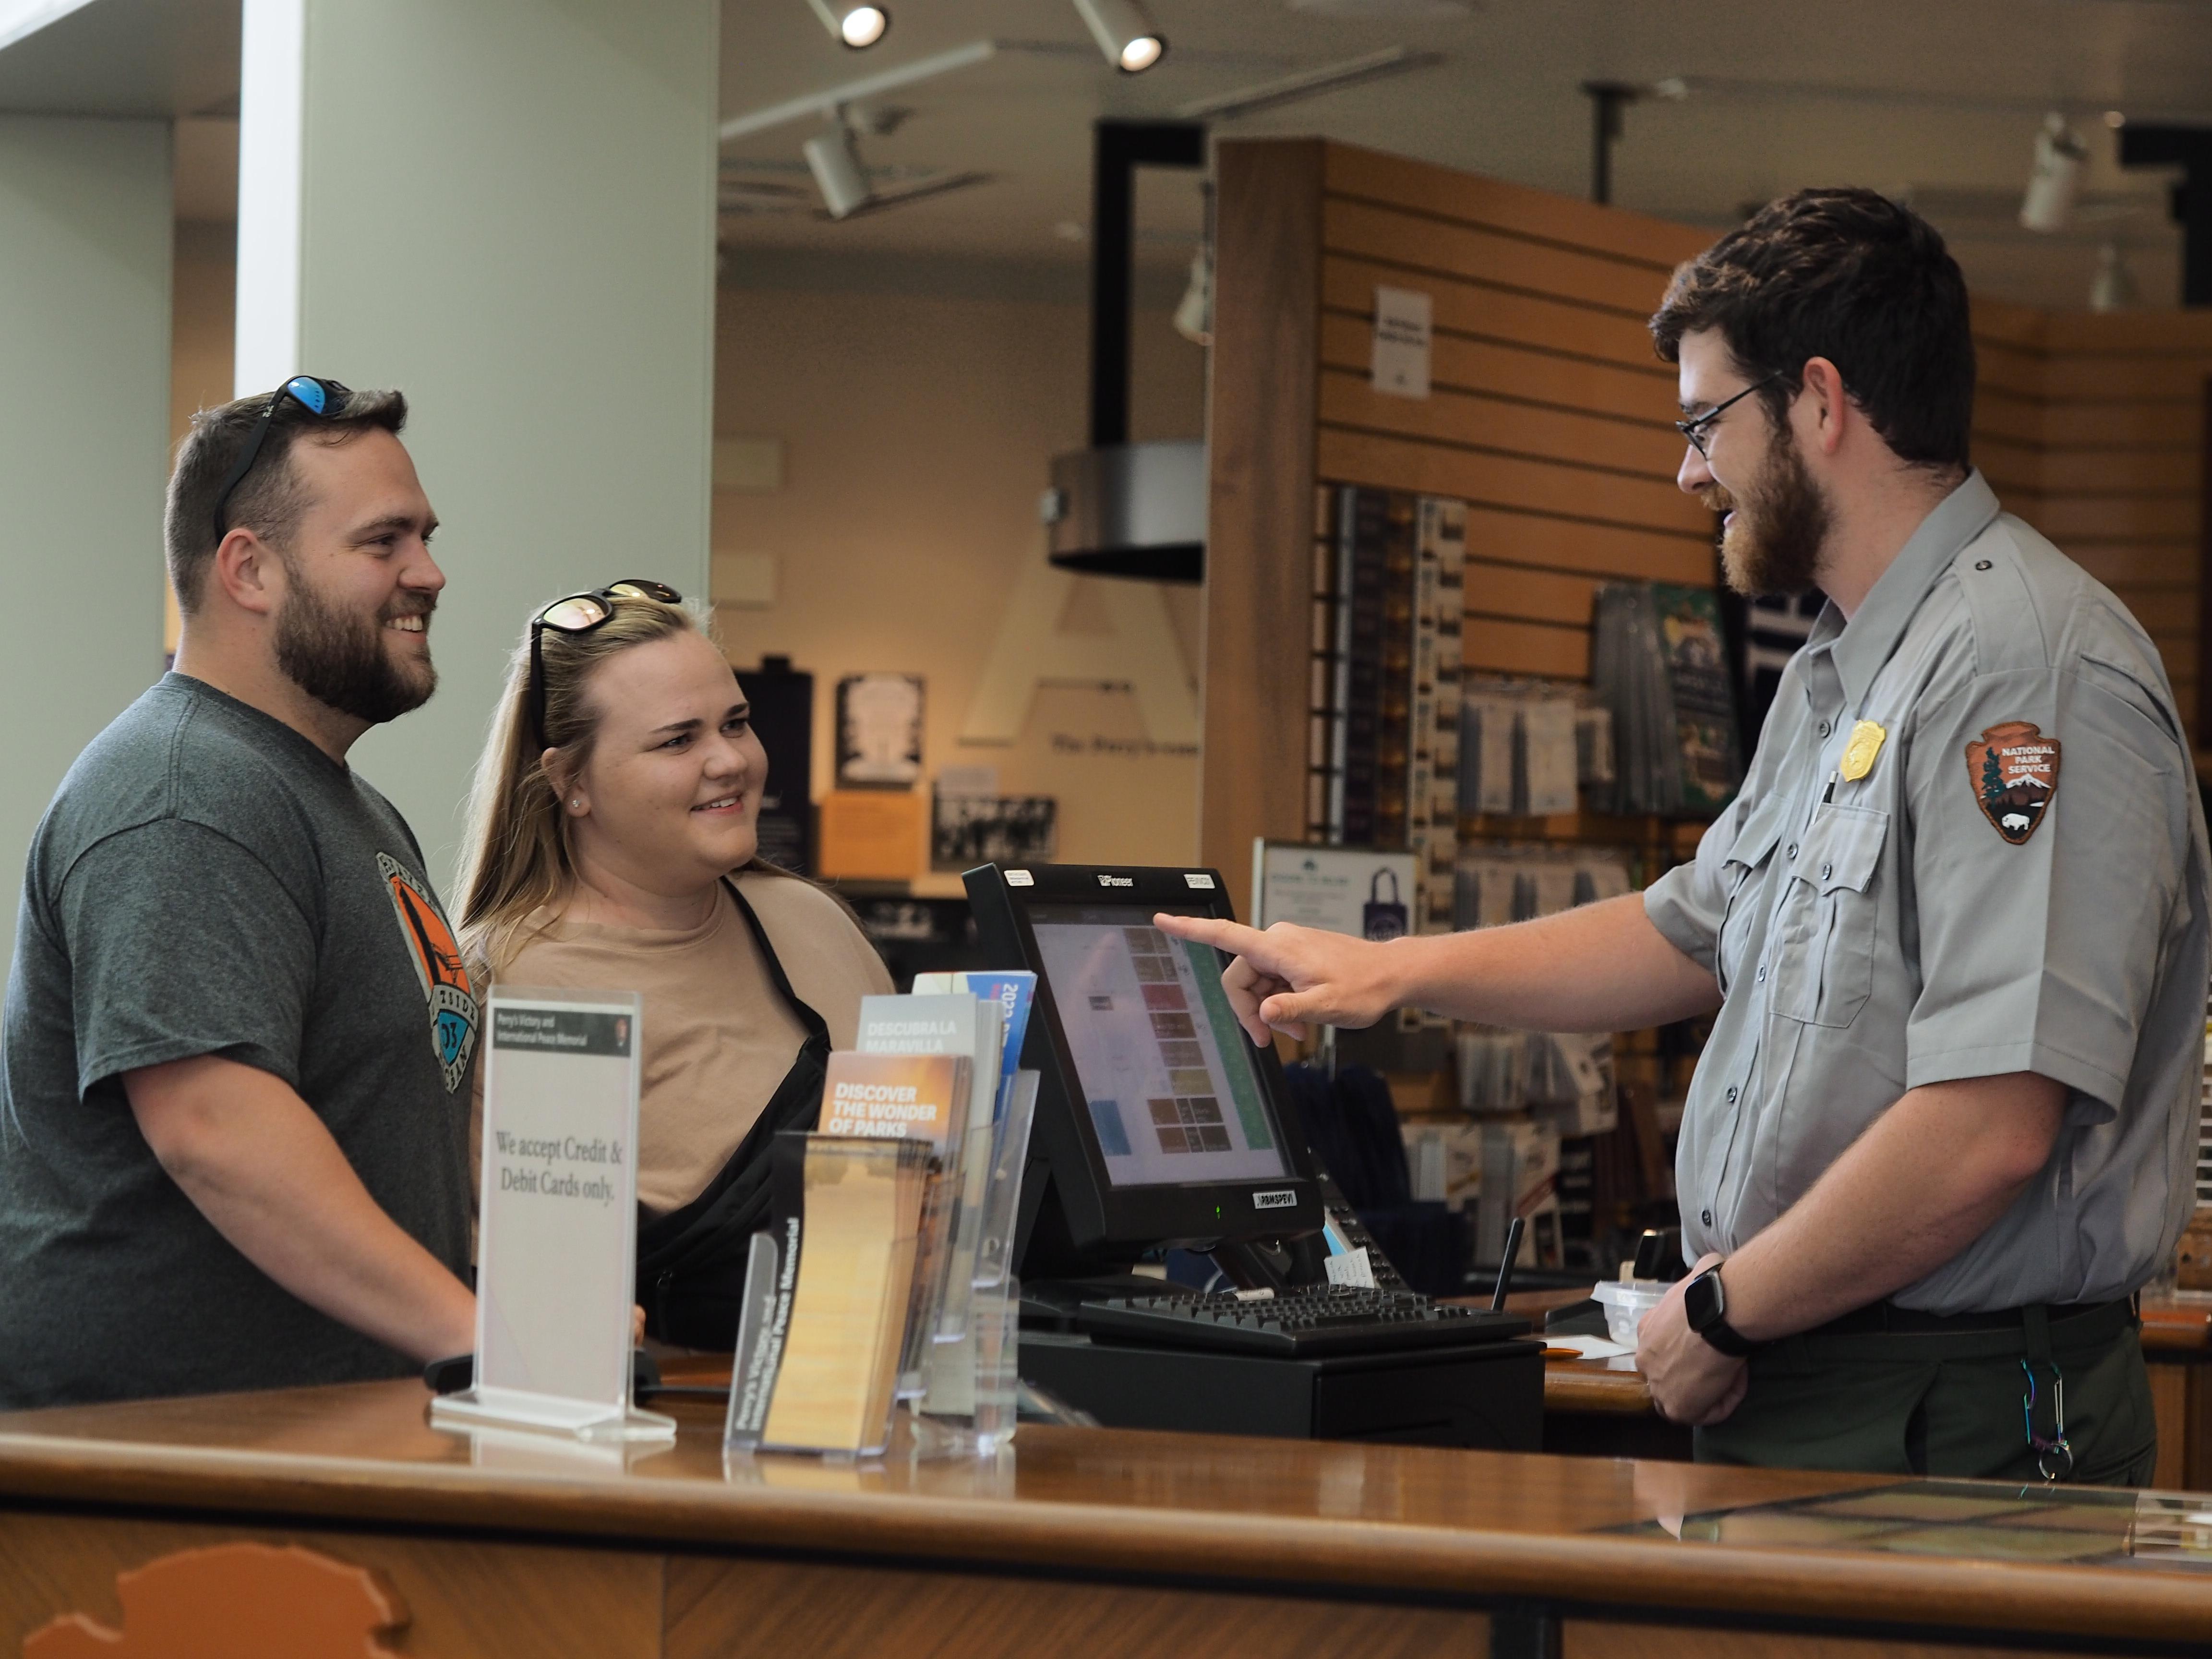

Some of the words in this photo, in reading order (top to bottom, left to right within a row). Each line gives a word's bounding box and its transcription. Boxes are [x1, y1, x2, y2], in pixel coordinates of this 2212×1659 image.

[2002, 745, 2055, 756] NATIONAL
[2015, 755, 2043, 764] PARK
[2008, 764, 2051, 774] SERVICE
[867, 1021, 937, 1037] DESCUBRA
[938, 1020, 957, 1035] LA
[865, 1039, 944, 1053] MARAVILLA
[835, 1082, 917, 1103] DISCOVER
[833, 1099, 866, 1118] THE
[869, 1103, 937, 1121] WONDER
[829, 1117, 854, 1134] OF
[854, 1120, 907, 1138] PARKS
[496, 1130, 517, 1154] We
[519, 1139, 561, 1166] accept
[565, 1136, 607, 1164] Credit
[611, 1140, 623, 1165] &
[501, 1166, 537, 1193] Debit
[541, 1171, 579, 1198] Cards
[583, 1175, 615, 1207] only.
[780, 1216, 800, 1290] Memorial
[771, 1291, 792, 1336] Peace
